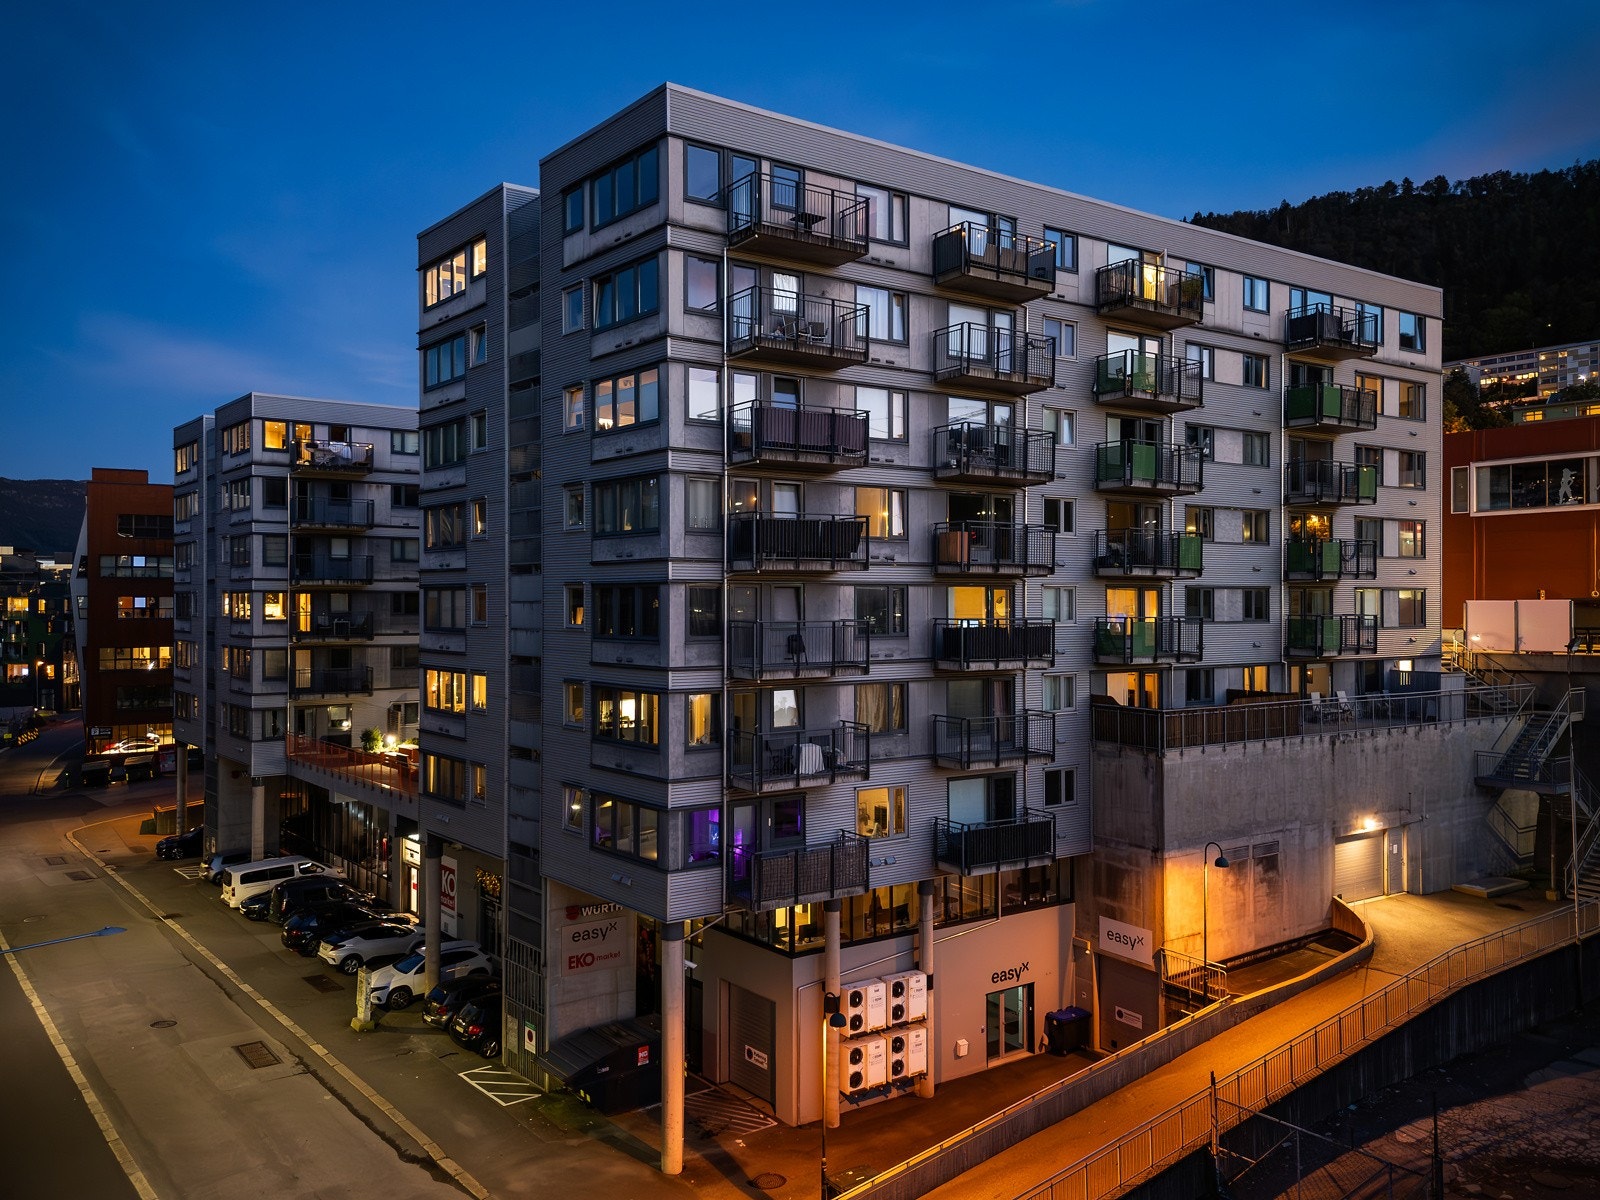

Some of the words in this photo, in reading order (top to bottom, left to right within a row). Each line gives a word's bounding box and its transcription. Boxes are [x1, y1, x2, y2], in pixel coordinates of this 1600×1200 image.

[442, 870, 456, 896] KO
[568, 952, 595, 970] EKO
[596, 951, 620, 961] market
